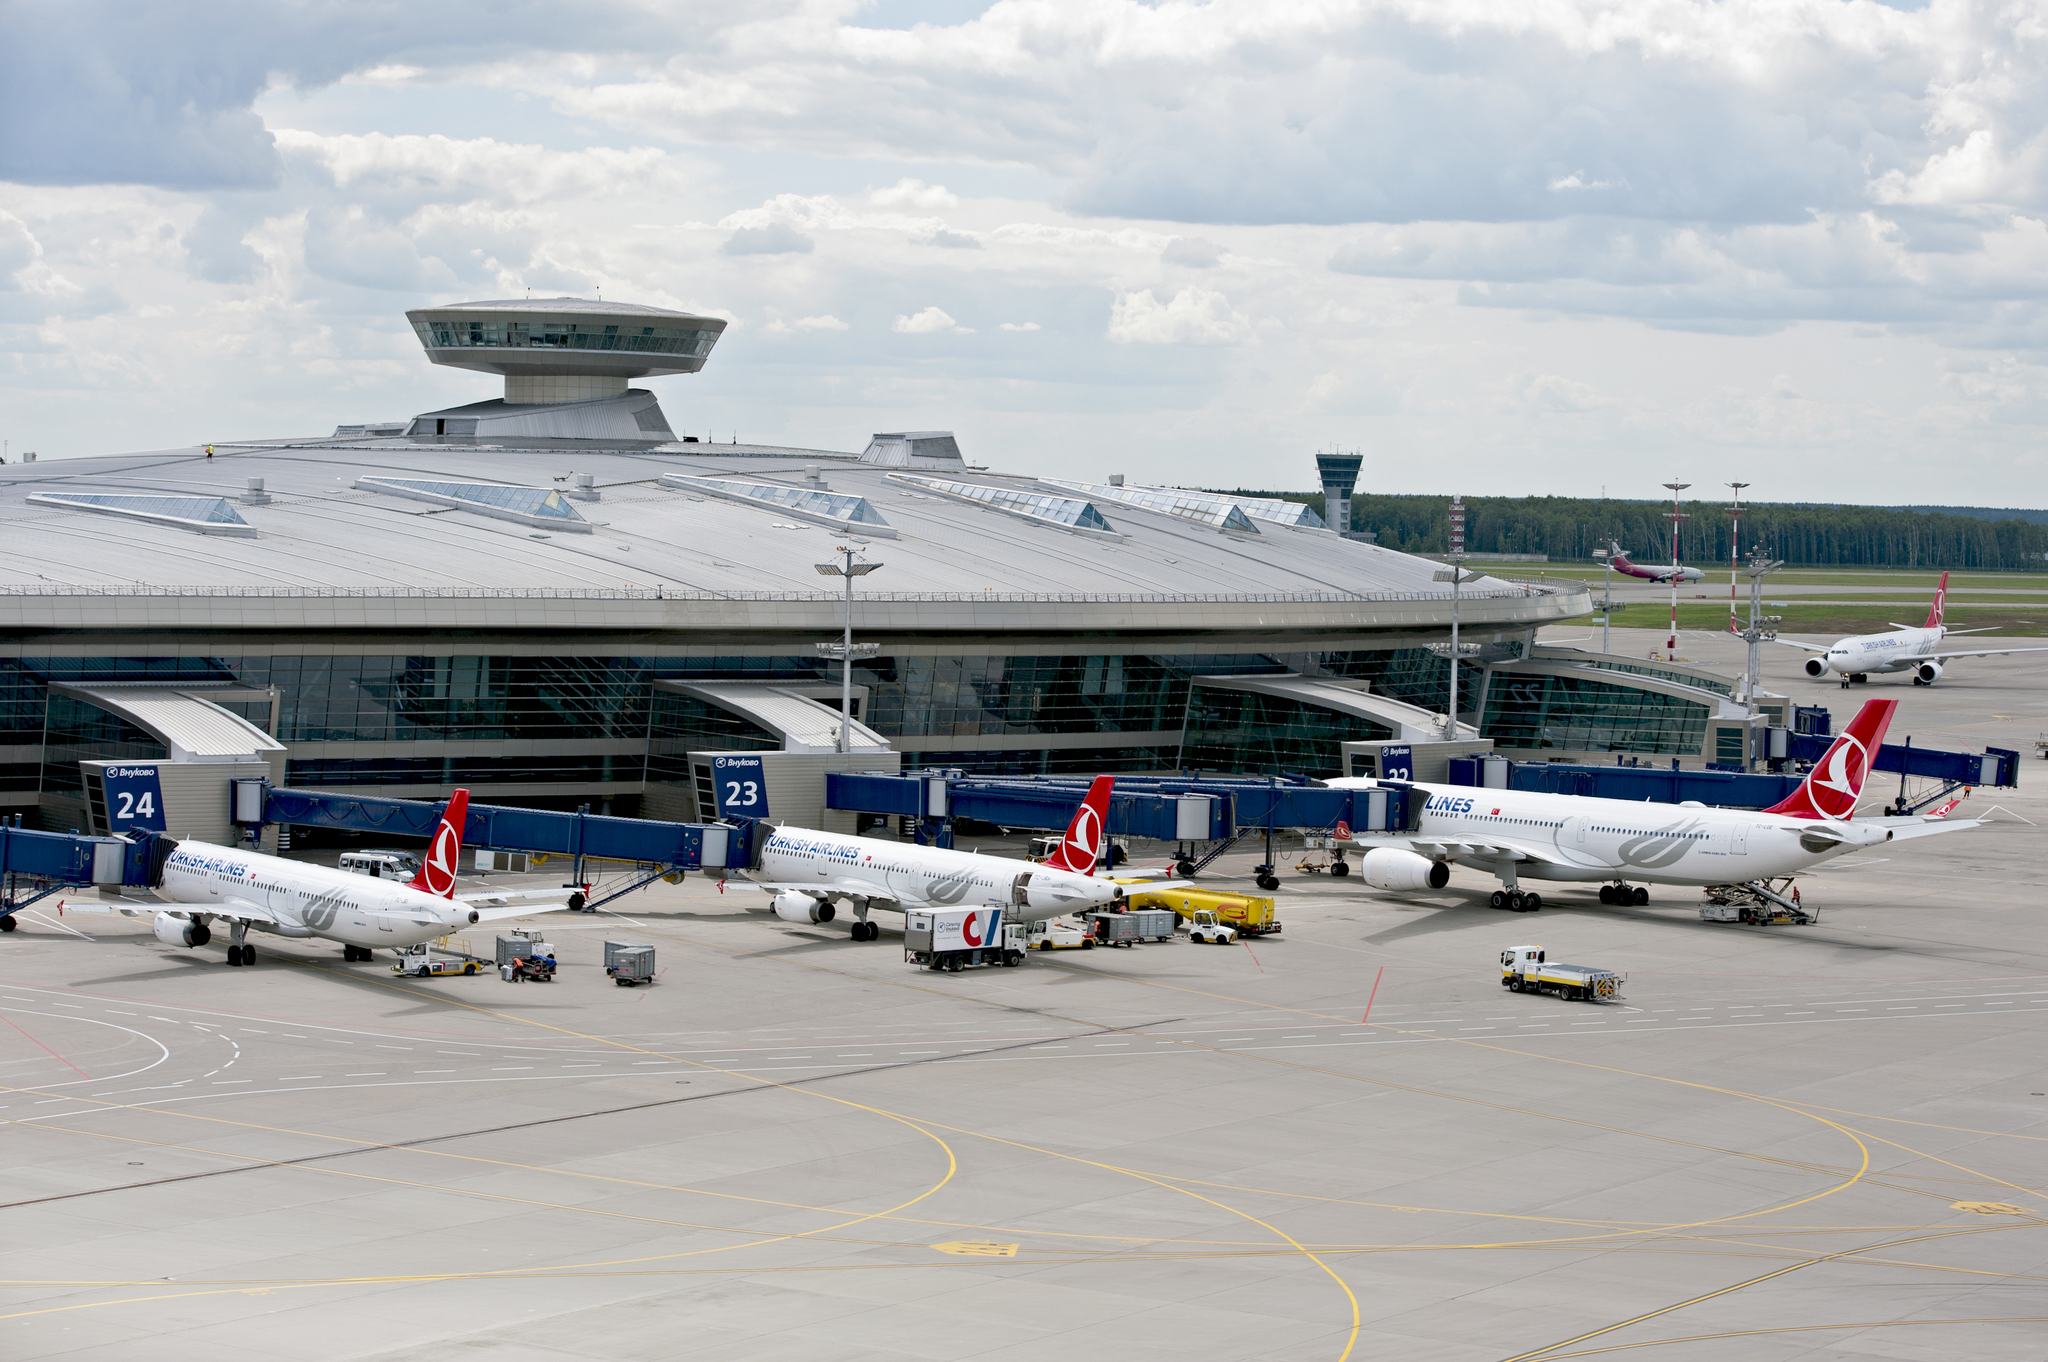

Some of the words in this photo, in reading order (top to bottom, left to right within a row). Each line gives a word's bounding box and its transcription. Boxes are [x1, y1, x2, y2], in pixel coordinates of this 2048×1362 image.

[119, 768, 155, 778] Внуково
[727, 758, 759, 768] Внуково
[117, 792, 155, 819] 24
[725, 781, 758, 806] 23
[764, 834, 811, 851] TURKISH
[809, 841, 862, 859] AIRLINES
[165, 848, 207, 868] TURKISH
[204, 858, 248, 877] AIRLINES
